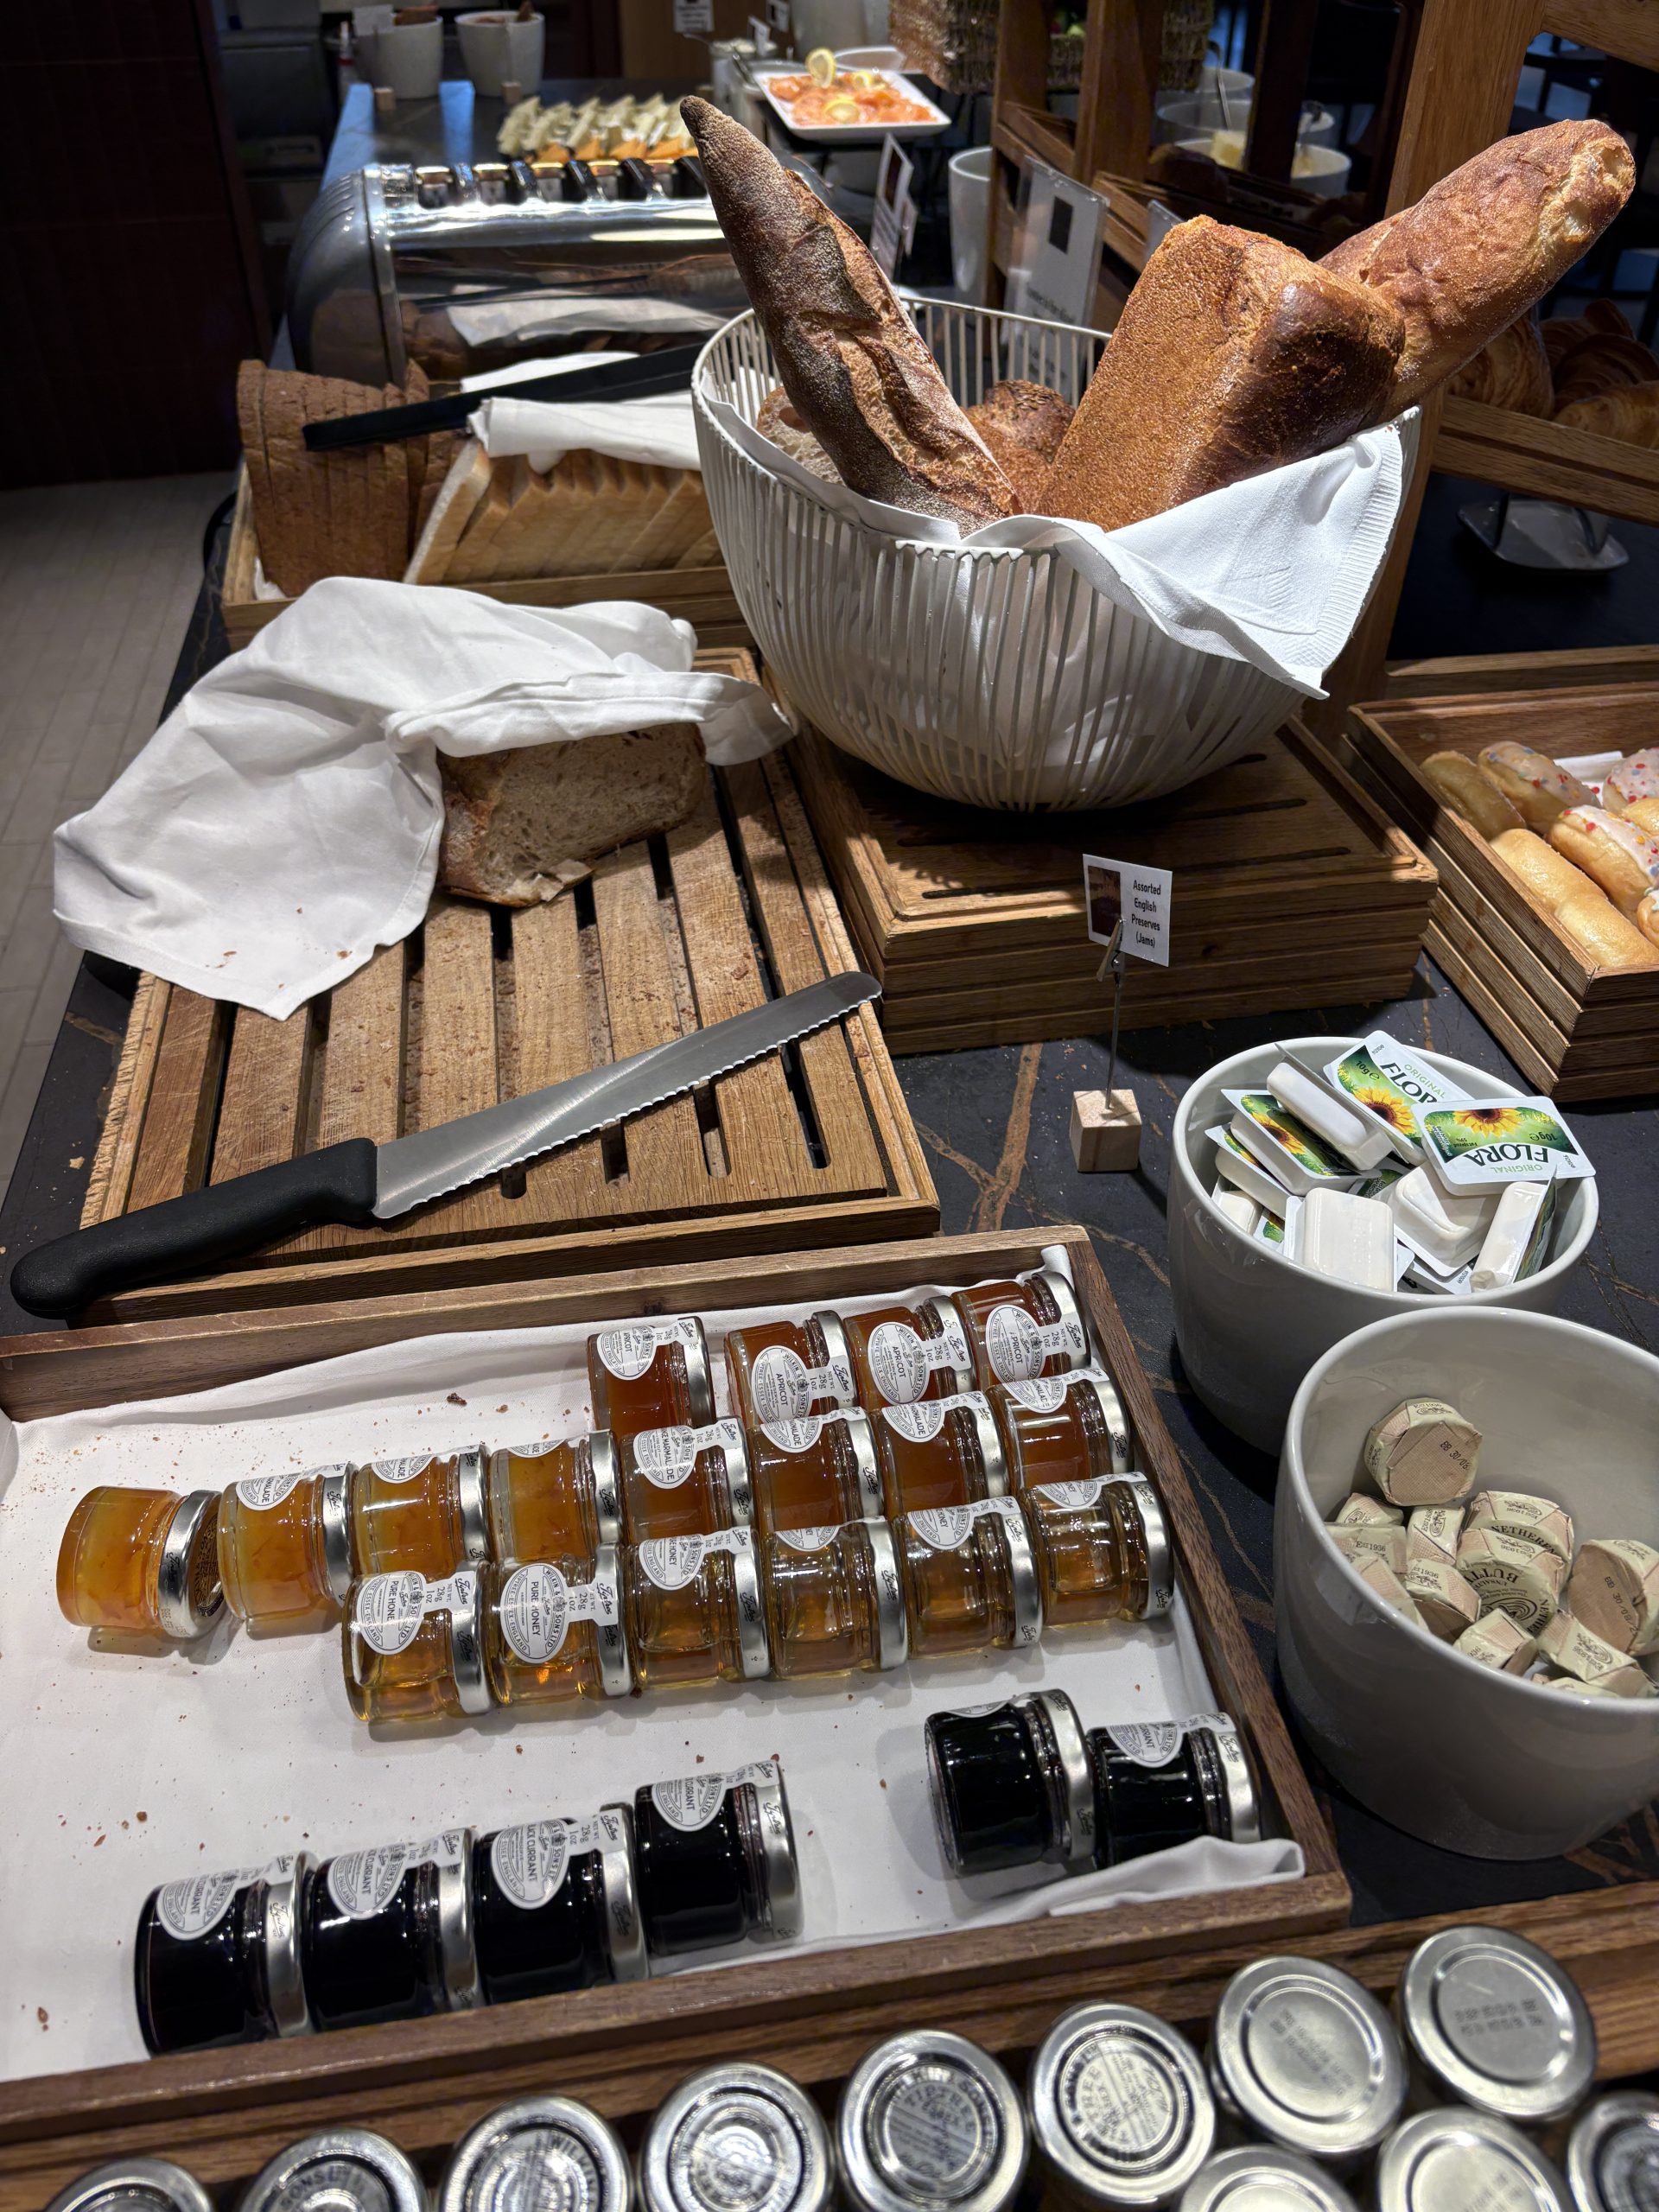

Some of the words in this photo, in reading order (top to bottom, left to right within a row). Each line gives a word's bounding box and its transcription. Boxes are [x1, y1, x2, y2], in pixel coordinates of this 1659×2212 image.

[1133, 880, 1161, 895] Assorted
[1134, 898, 1157, 913] English
[1131, 913, 1160, 931] Preserves
[1135, 931, 1156, 949] (Jams)
[1404, 1064, 1446, 1098] ORIGINAL
[1463, 1143, 1548, 1166] FLORA
[1491, 1164, 1542, 1174] ORIGINAL
[1051, 1332, 1059, 1347] 28g
[1063, 1322, 1082, 1349] Tiptree
[934, 1344, 943, 1361] 28g
[946, 1335, 966, 1363] Tiptree
[893, 1346, 906, 1378] APRICOT
[776, 1372, 788, 1407] APRICOT
[661, 1438, 675, 1481] MARMALDE
[669, 1546, 677, 1566] HONEY
[1370, 1542, 1387, 1552] 1936
[389, 1580, 399, 1600] PURE
[545, 1570, 560, 1589] WILKIN
[434, 1586, 445, 1604] 28g
[454, 1578, 471, 1605] Tiptree
[531, 1581, 540, 1604] PURE
[577, 1592, 588, 1610] 28g
[597, 1582, 613, 1615] Tiptree
[386, 1597, 397, 1623] HONE
[554, 1613, 563, 1634] SONS
[509, 1622, 528, 1651] ENGLAND
[547, 1633, 557, 1649] LTD
[526, 1839, 537, 1882] CURRANT
[362, 1857, 375, 1894] CURRANT
